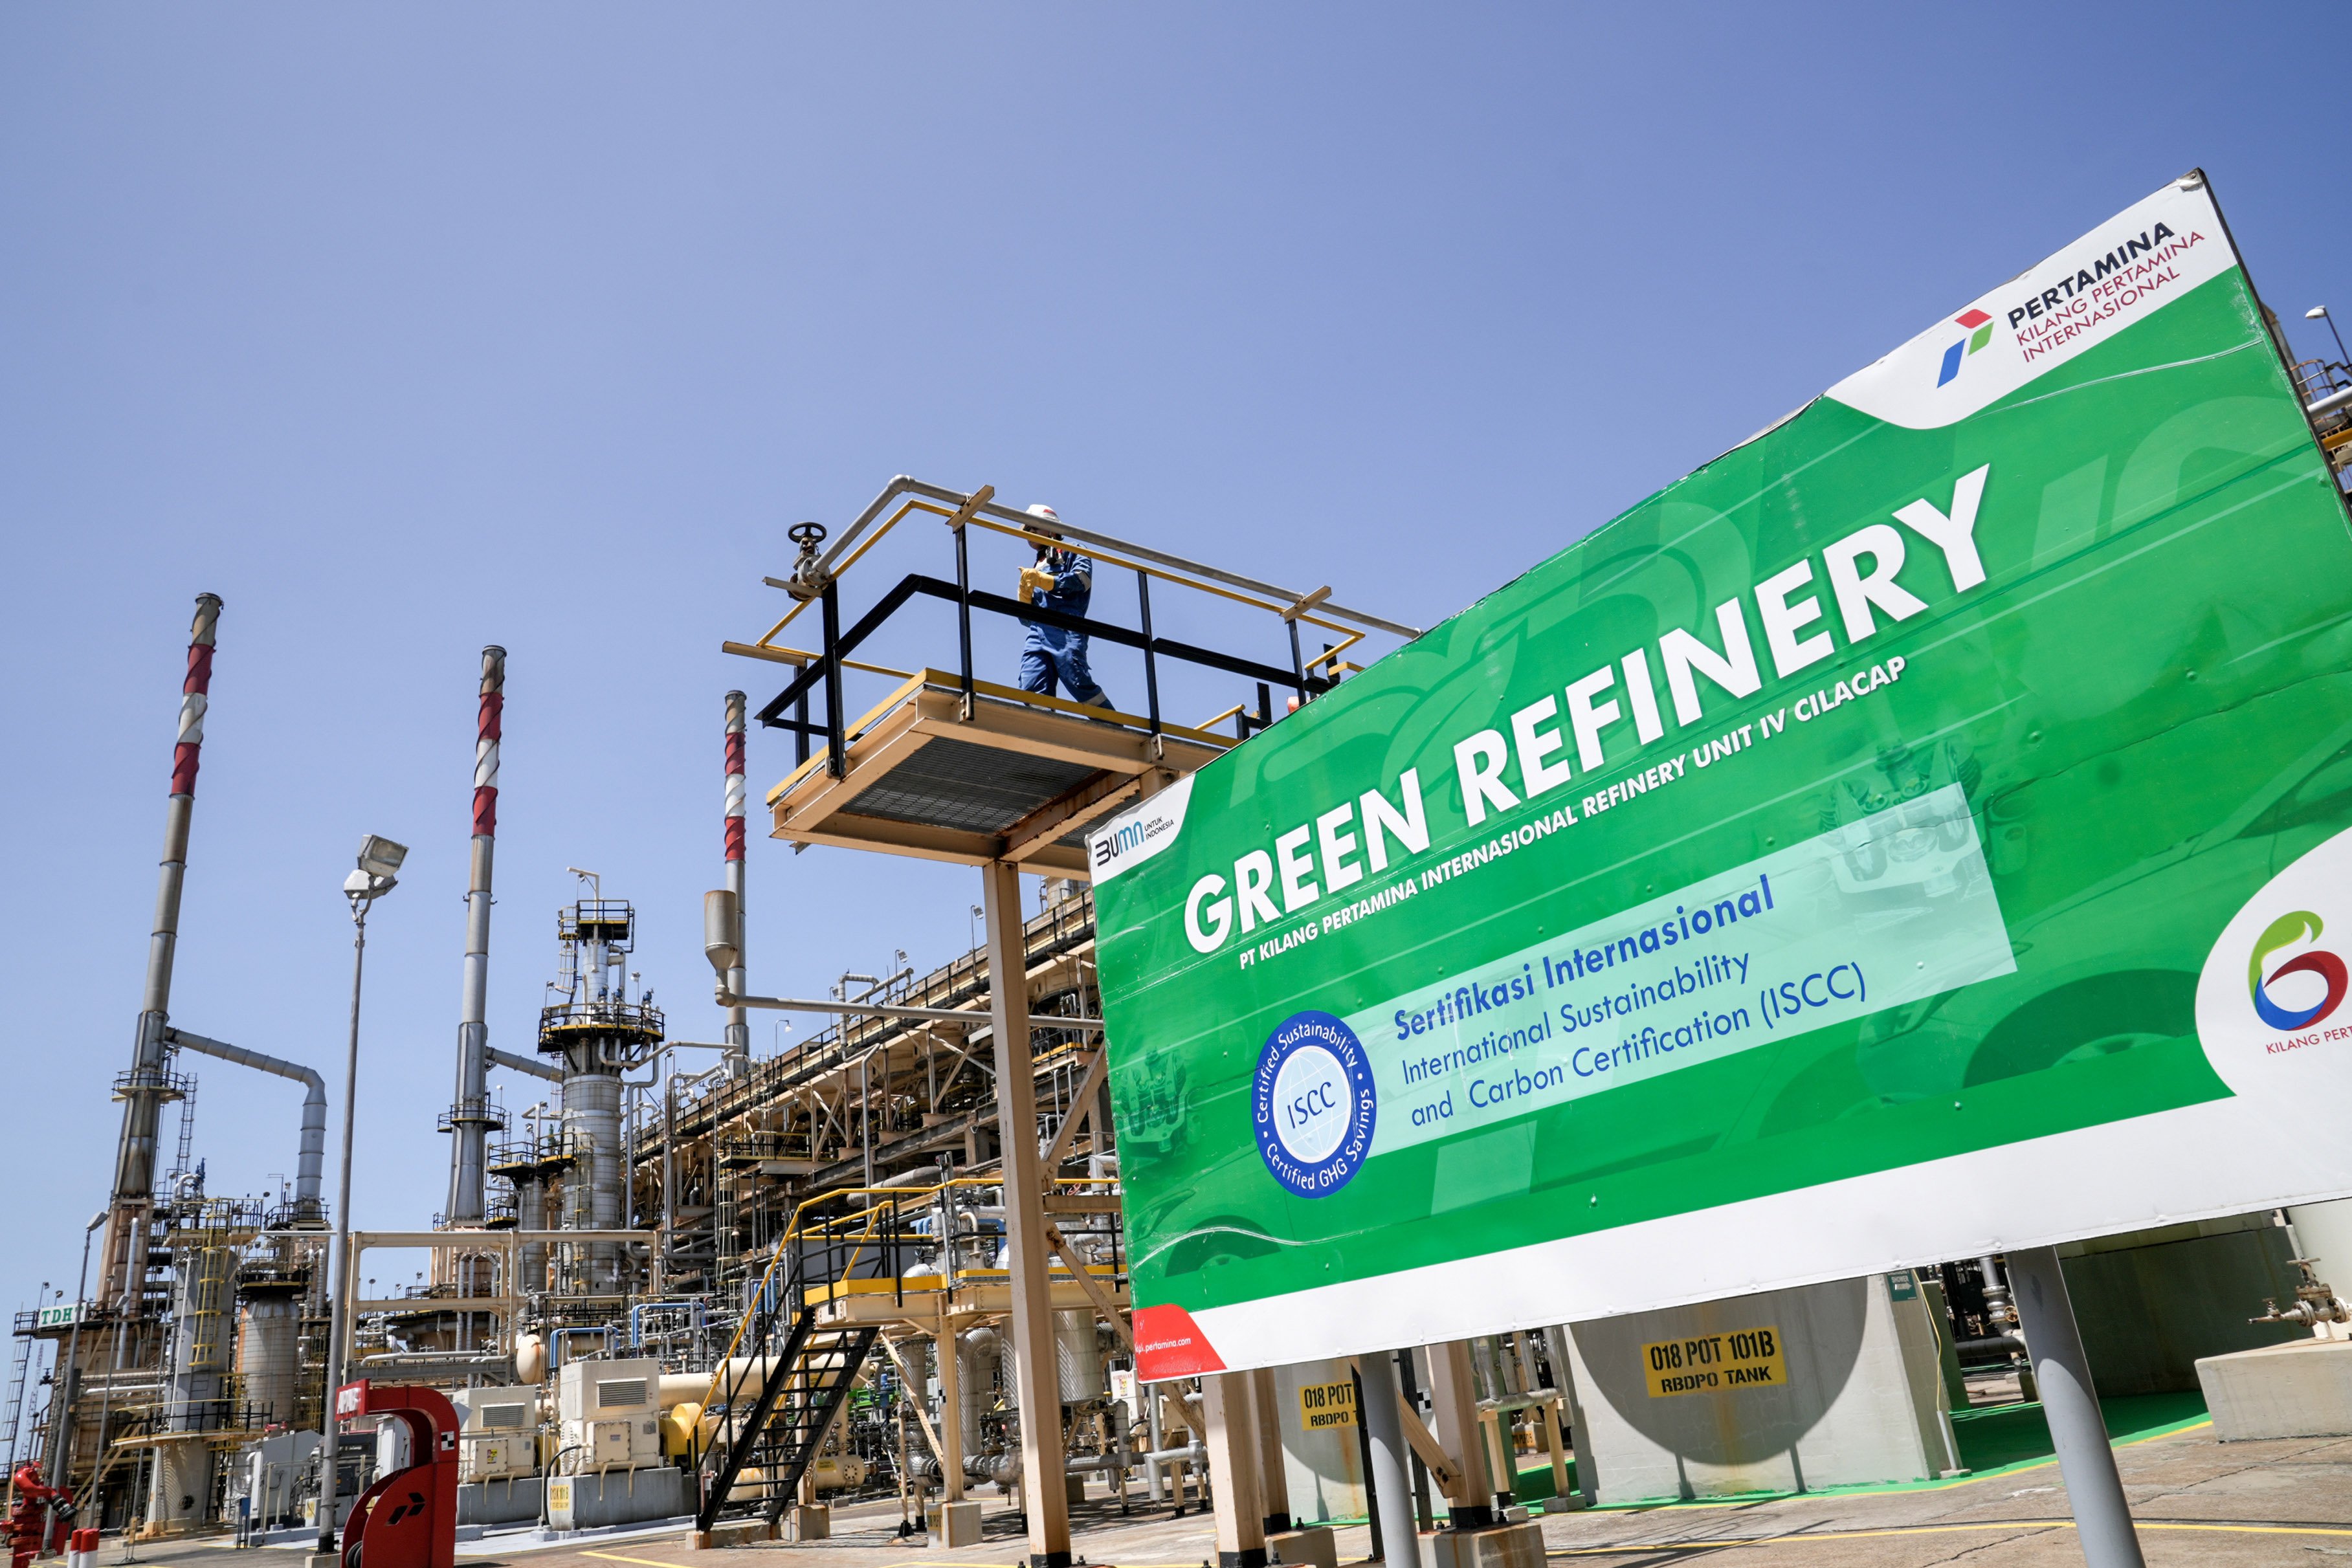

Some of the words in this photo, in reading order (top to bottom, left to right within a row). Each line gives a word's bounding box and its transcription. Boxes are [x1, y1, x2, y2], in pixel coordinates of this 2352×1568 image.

[2008, 222, 2175, 329] PERTAMINA
[2017, 298, 2087, 346] KILANG
[2092, 231, 2205, 303] PERTAMINA
[2023, 266, 2180, 362] INTERNASIONAL
[1184, 767, 1430, 954] GREEN
[1453, 463, 1990, 827] REFINERY
[1144, 816, 1162, 831] UNTUK
[1146, 819, 1174, 840] INDONESIA
[1239, 949, 1255, 969] PT
[1259, 922, 1318, 961] KILANG
[1322, 878, 1418, 934] PERTAMINA
[1421, 806, 1578, 890] INTERNASIONAL
[1582, 754, 1685, 817] REFINERY
[1692, 724, 1752, 768] UNIT
[1760, 708, 1785, 739] IV
[1794, 656, 1905, 722] CILACAP
[1395, 963, 1535, 1040] Sertifikasi
[1542, 874, 1774, 989] Internasional
[1403, 1011, 1551, 1085] International
[1560, 953, 1749, 1033] Sustainability
[1412, 1090, 1454, 1126] and
[1469, 1065, 1564, 1108] Carbon
[1573, 1007, 1750, 1077] Certification
[1760, 962, 1865, 1030] (ISCC)
[2266, 1033, 2320, 1054] KILANG
[1258, 1046, 1280, 1123] Certified
[1278, 1020, 1358, 1067] Sustainability
[1287, 1081, 1336, 1129] ISCC
[1267, 1143, 1315, 1189] Certified
[1319, 1158, 1348, 1187] GHG
[1346, 1088, 1373, 1162] Savings
[1304, 1387, 1325, 1408] 018
[1327, 1384, 1352, 1406] POT
[1650, 1343, 1682, 1371] 018
[1685, 1337, 1721, 1366] POT
[1728, 1331, 1775, 1360] 101B
[1661, 1372, 1718, 1393] RBDPO
[1724, 1366, 1772, 1384] TANK
[1311, 1411, 1349, 1426] RBDPO
